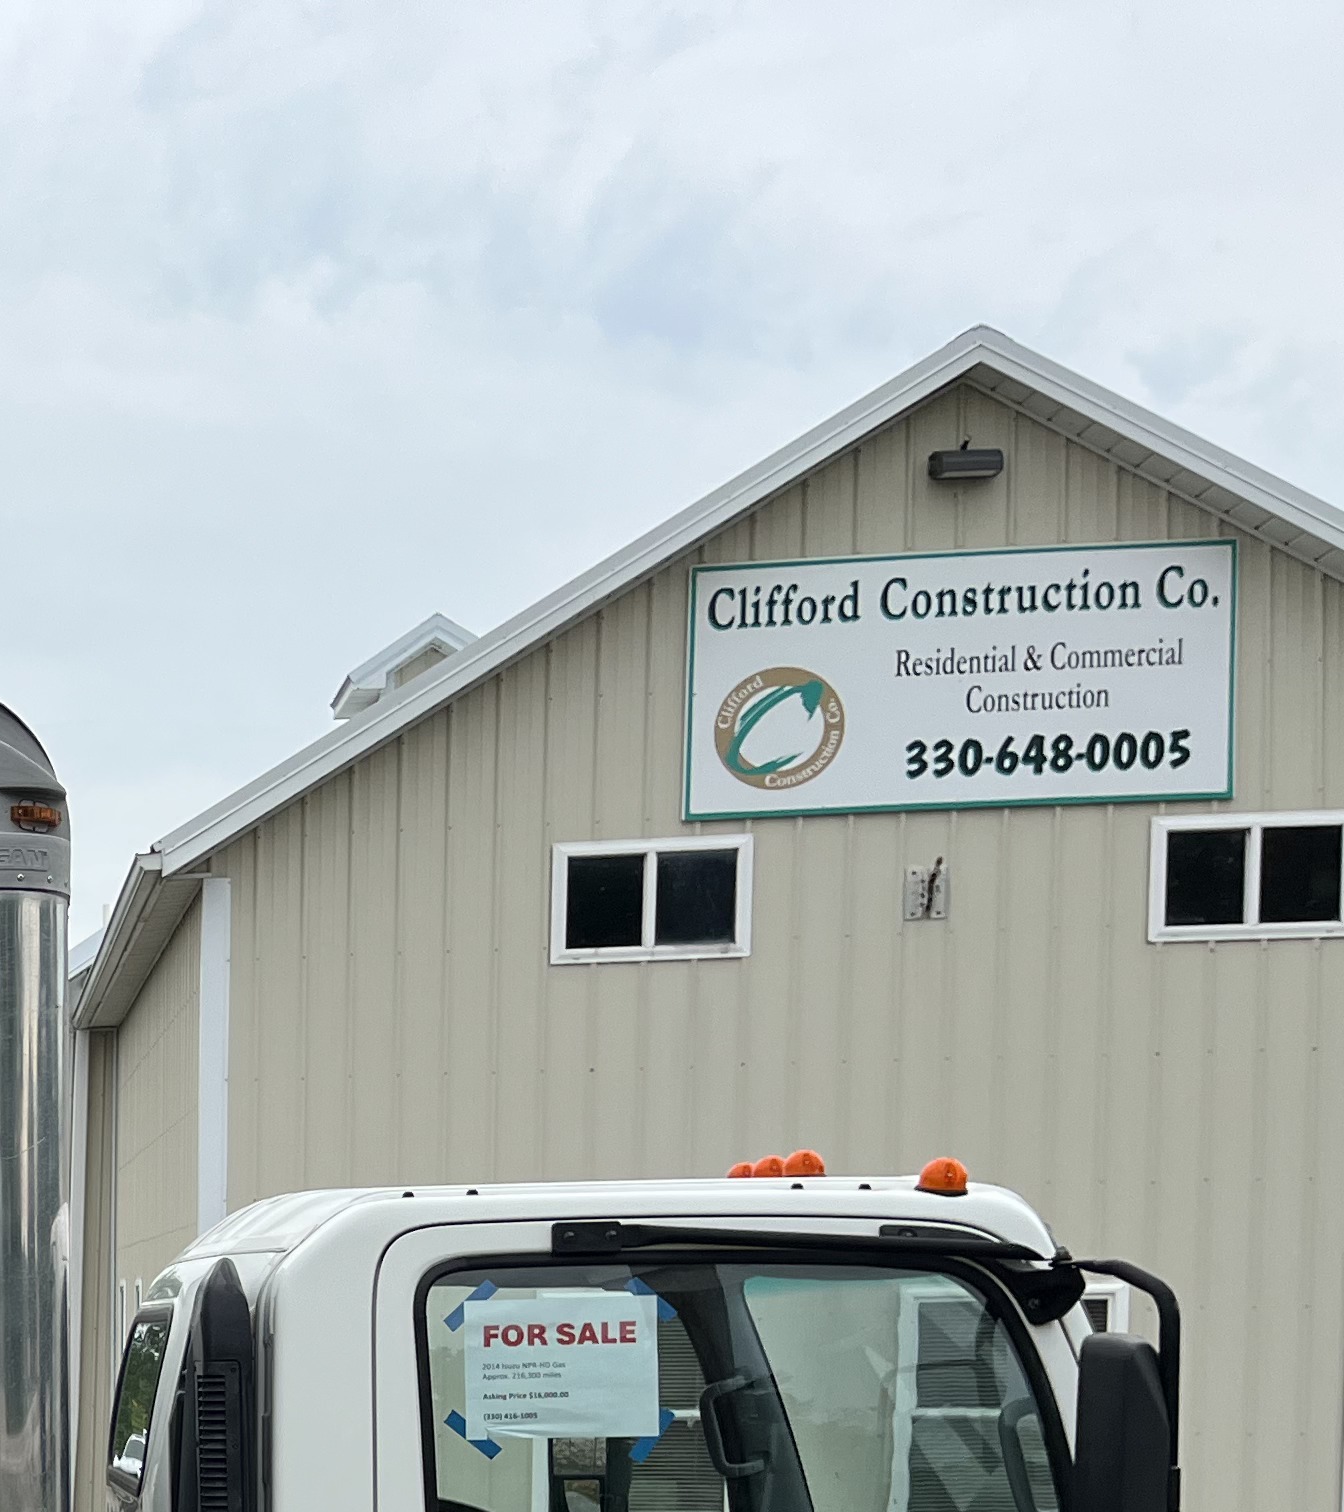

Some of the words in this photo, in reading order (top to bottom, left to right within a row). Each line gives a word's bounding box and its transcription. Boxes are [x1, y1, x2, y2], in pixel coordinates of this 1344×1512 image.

[707, 579, 861, 631] Clifford
[880, 568, 1141, 621] Construction
[1156, 564, 1220, 609] Co.
[894, 644, 1017, 678] Residential
[1023, 646, 1044, 670] &
[1050, 639, 1185, 671] Commercial
[966, 685, 1110, 715] Construction
[717, 675, 764, 730] Clifford
[764, 730, 840, 787] Construction
[905, 728, 1192, 779] 330-648-0005
[483, 1323, 548, 1347] FOR
[556, 1320, 637, 1345] SALE
